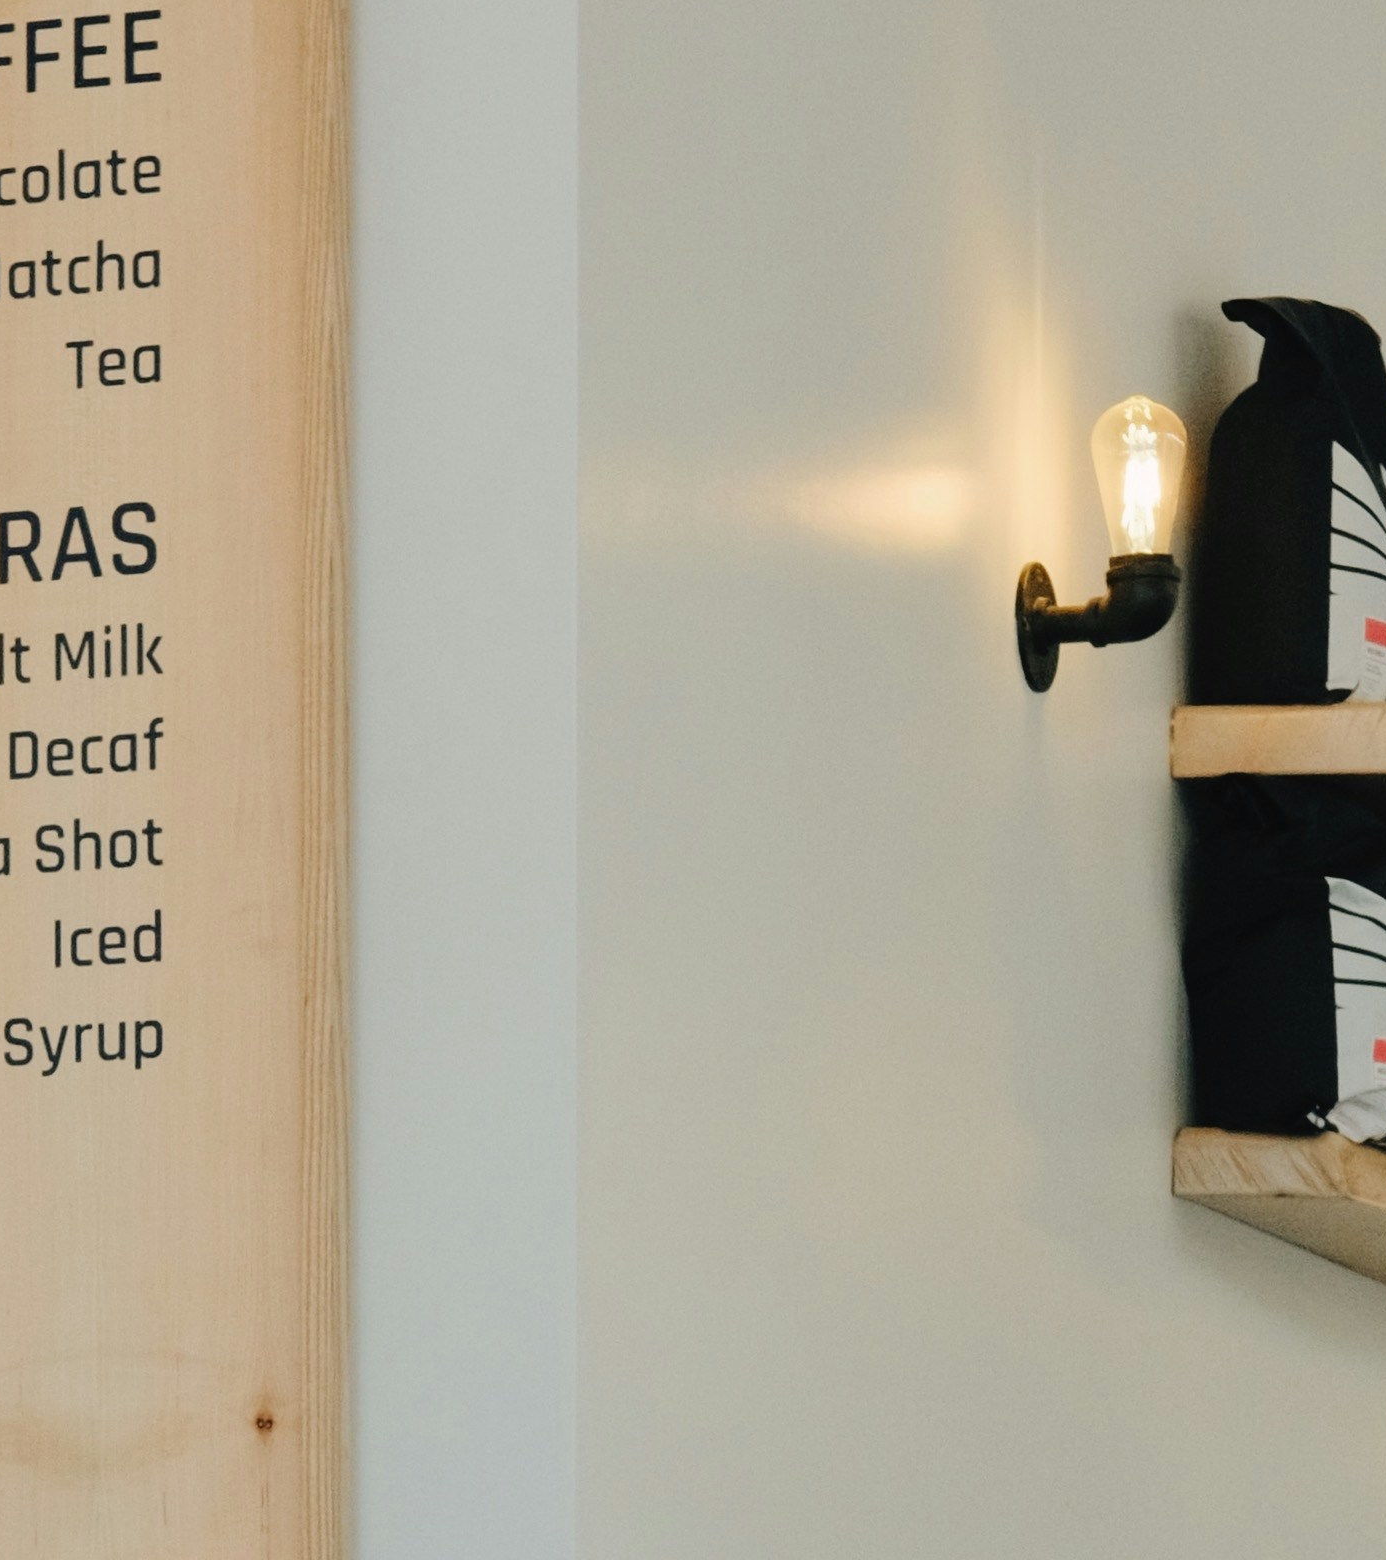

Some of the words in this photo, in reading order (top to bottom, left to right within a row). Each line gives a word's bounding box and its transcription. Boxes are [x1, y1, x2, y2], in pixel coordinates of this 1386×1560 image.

[65, 339, 161, 390] Tea
[54, 622, 164, 682] Milk
[9, 716, 164, 780] Decaf
[35, 818, 164, 874] Shot
[54, 908, 162, 969] Iced
[3, 1017, 164, 1077] Syrup
